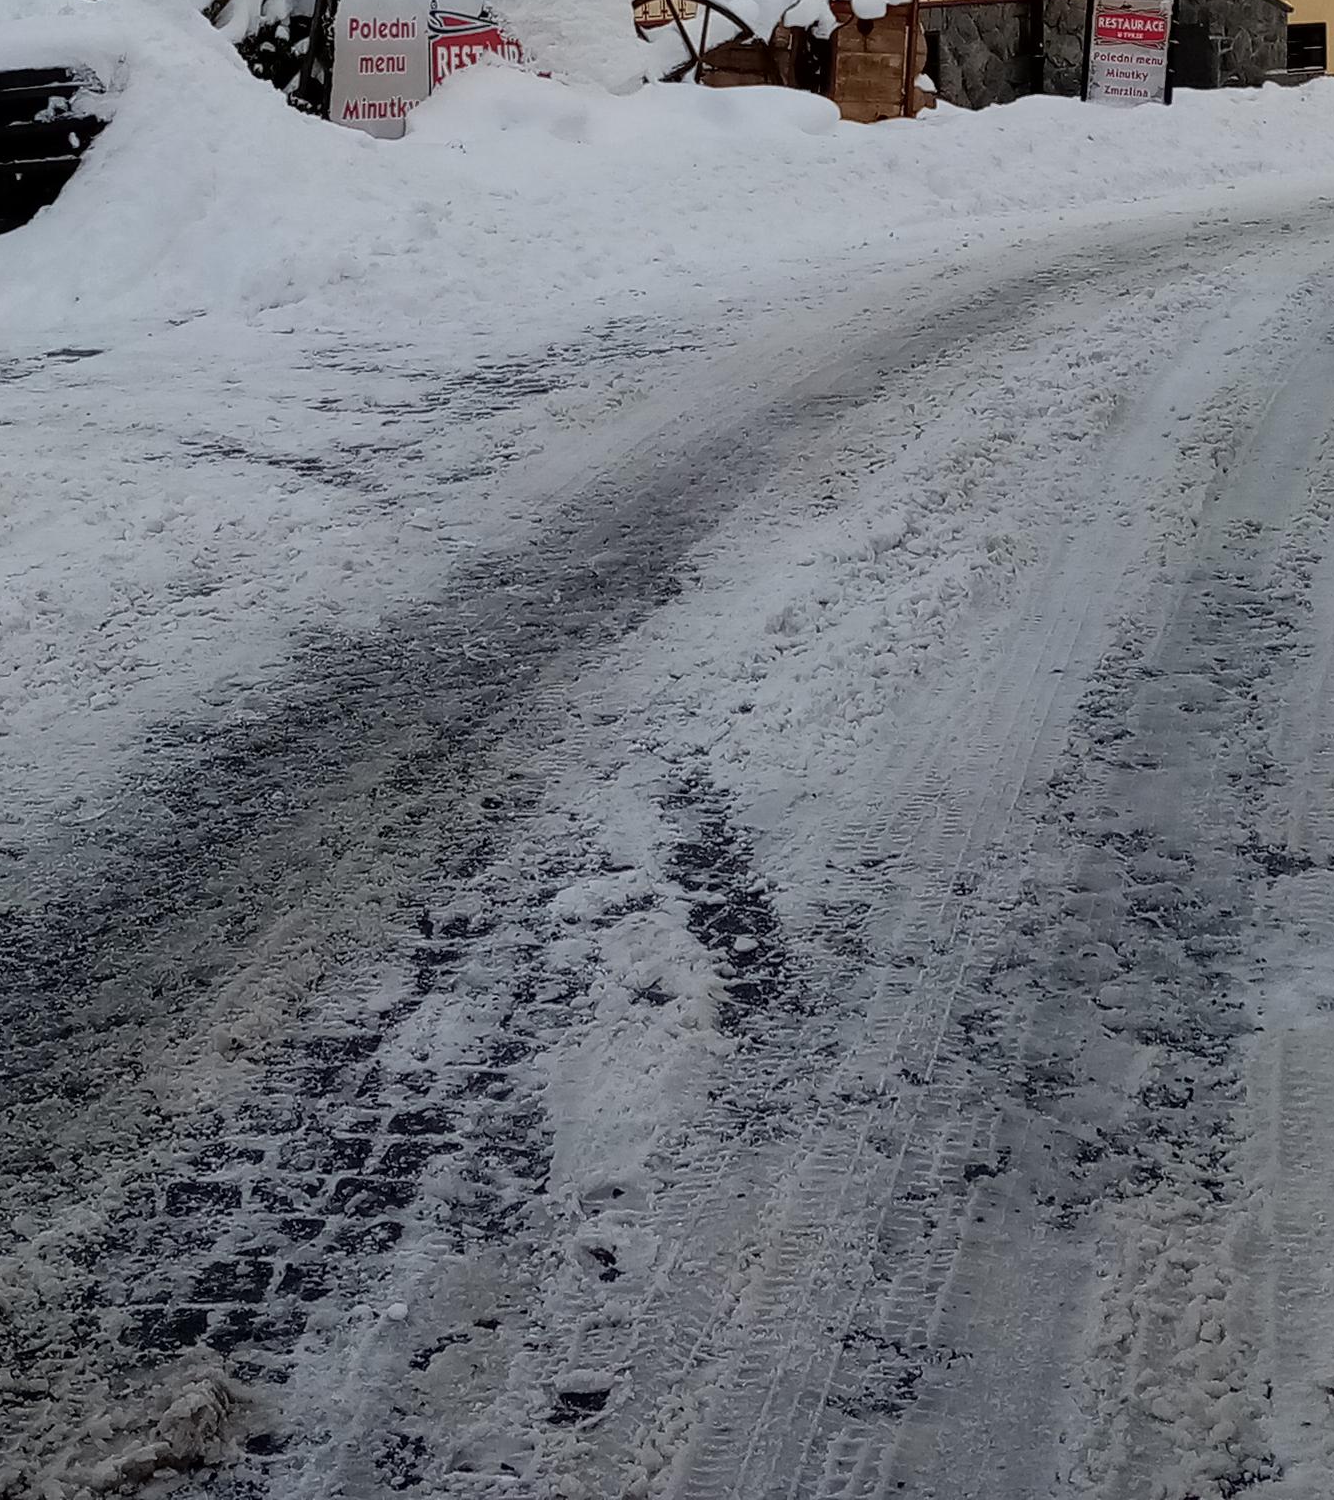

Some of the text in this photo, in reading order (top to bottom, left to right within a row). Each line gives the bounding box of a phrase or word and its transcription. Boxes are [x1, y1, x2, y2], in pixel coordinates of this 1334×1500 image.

[348, 17, 417, 40] Polední
[1097, 16, 1165, 32] RESTAURACE
[359, 54, 407, 74] menu
[1093, 51, 1163, 66] Polední menu
[1105, 68, 1149, 81] Minutky
[1103, 85, 1149, 97] Zmrzlina
